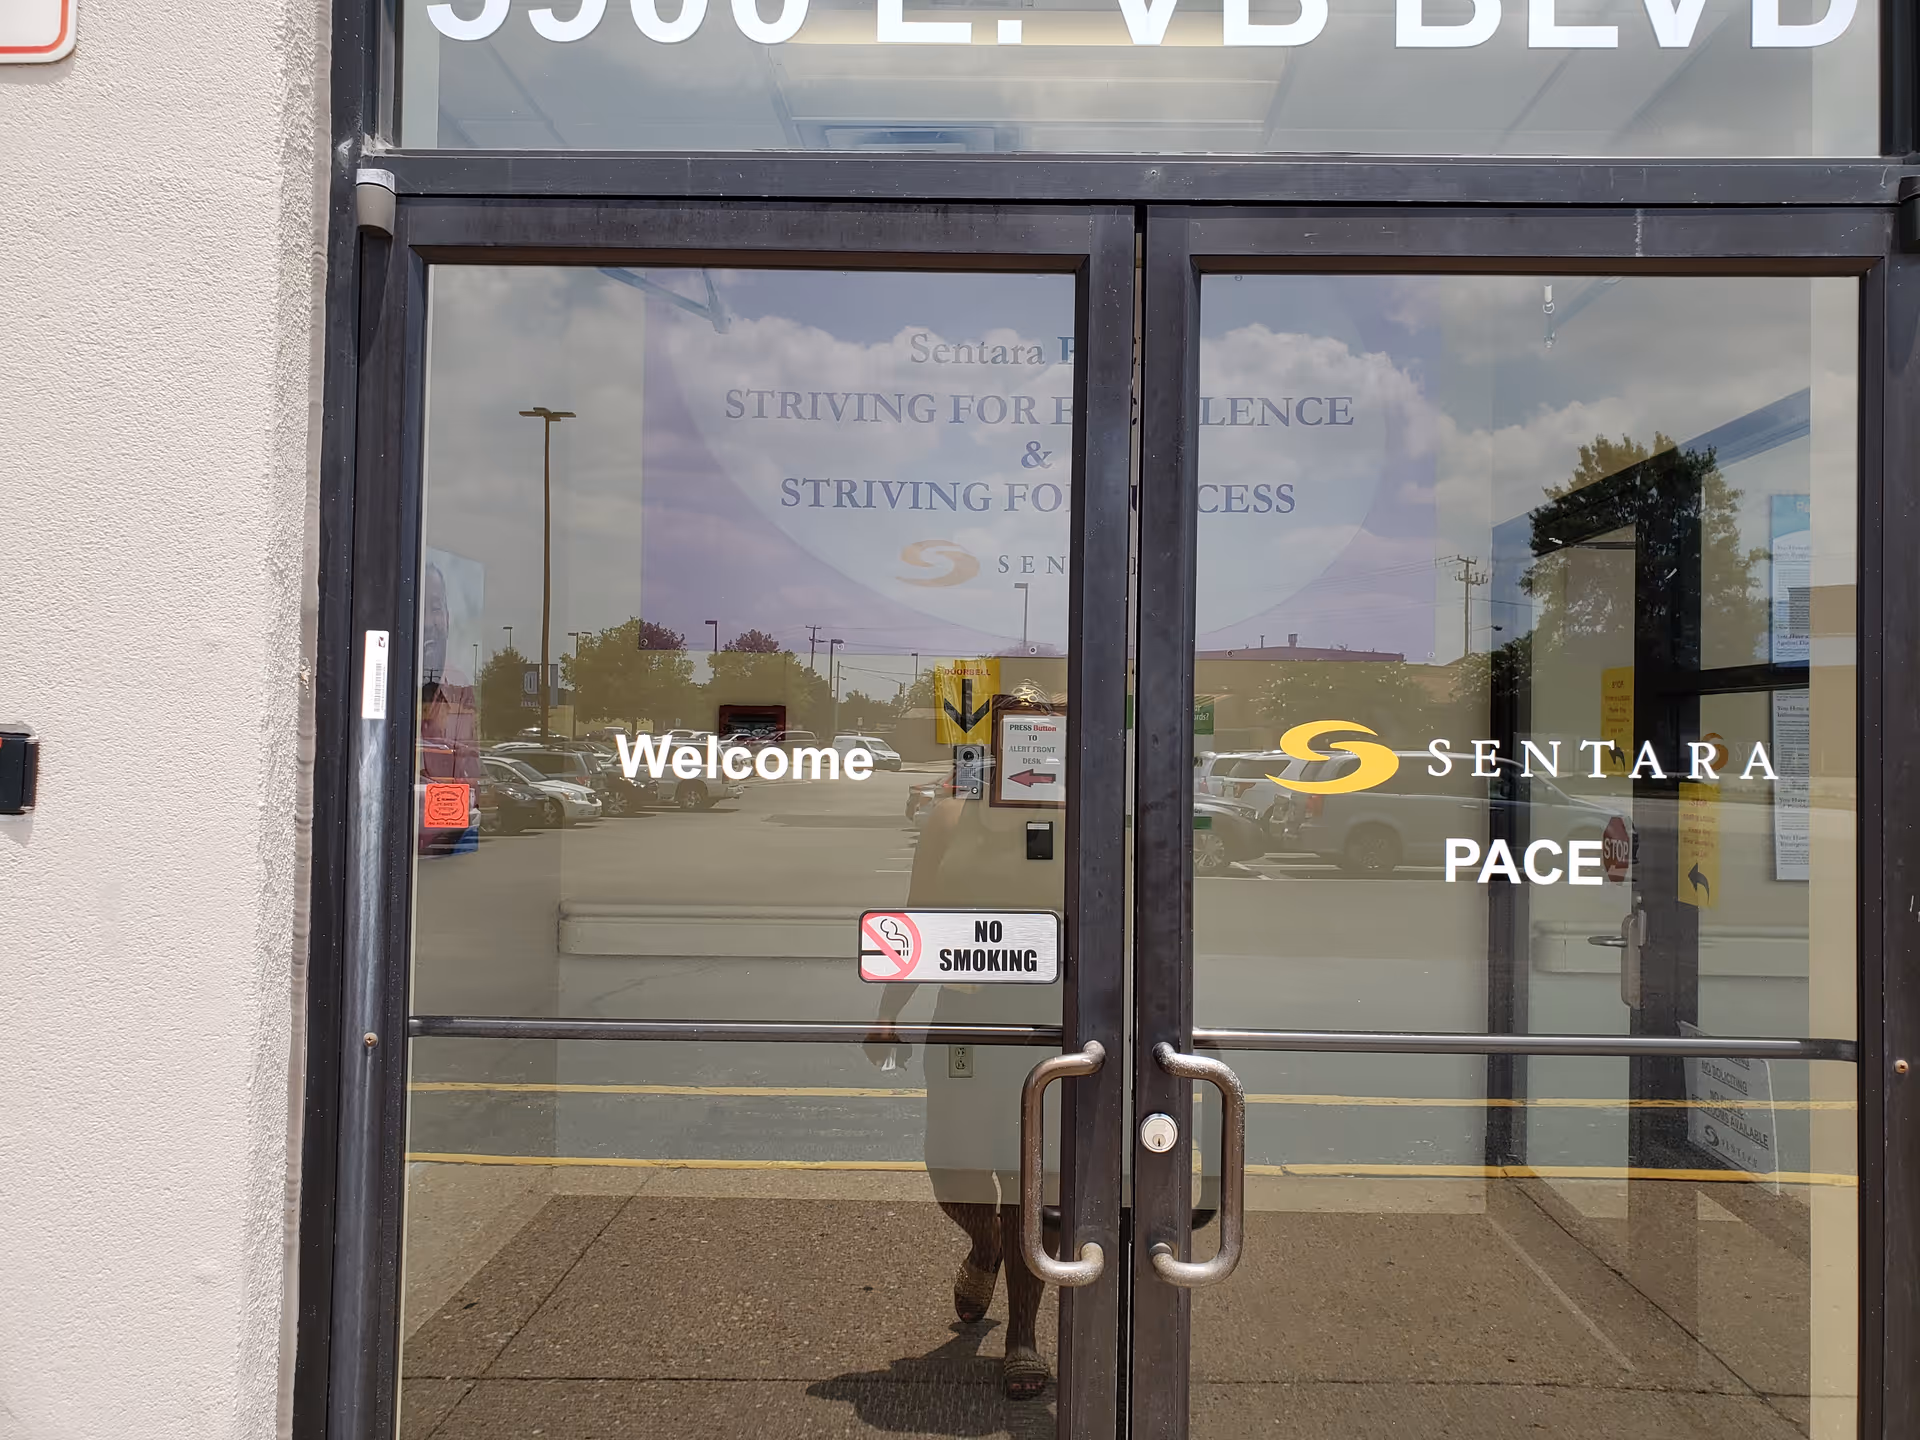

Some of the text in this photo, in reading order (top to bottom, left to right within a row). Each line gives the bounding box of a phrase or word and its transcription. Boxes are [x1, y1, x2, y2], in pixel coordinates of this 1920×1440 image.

[910, 333, 1045, 365] Sentara
[725, 389, 937, 422] STRIVING
[949, 394, 1040, 425] FOR
[1021, 441, 1053, 469] &
[780, 478, 993, 512] STRIVING
[1004, 483, 1070, 513] FO
[1009, 724, 1032, 732] PRESS
[615, 734, 874, 781] Welcome
[1009, 745, 1031, 753] ALERT
[1023, 757, 1042, 765] DESK
[1427, 738, 1779, 780] SENTARA
[1445, 838, 1603, 886] PACE
[1604, 837, 1629, 862] STOP
[974, 920, 1003, 943] NO
[939, 949, 1038, 972] SMOKING
